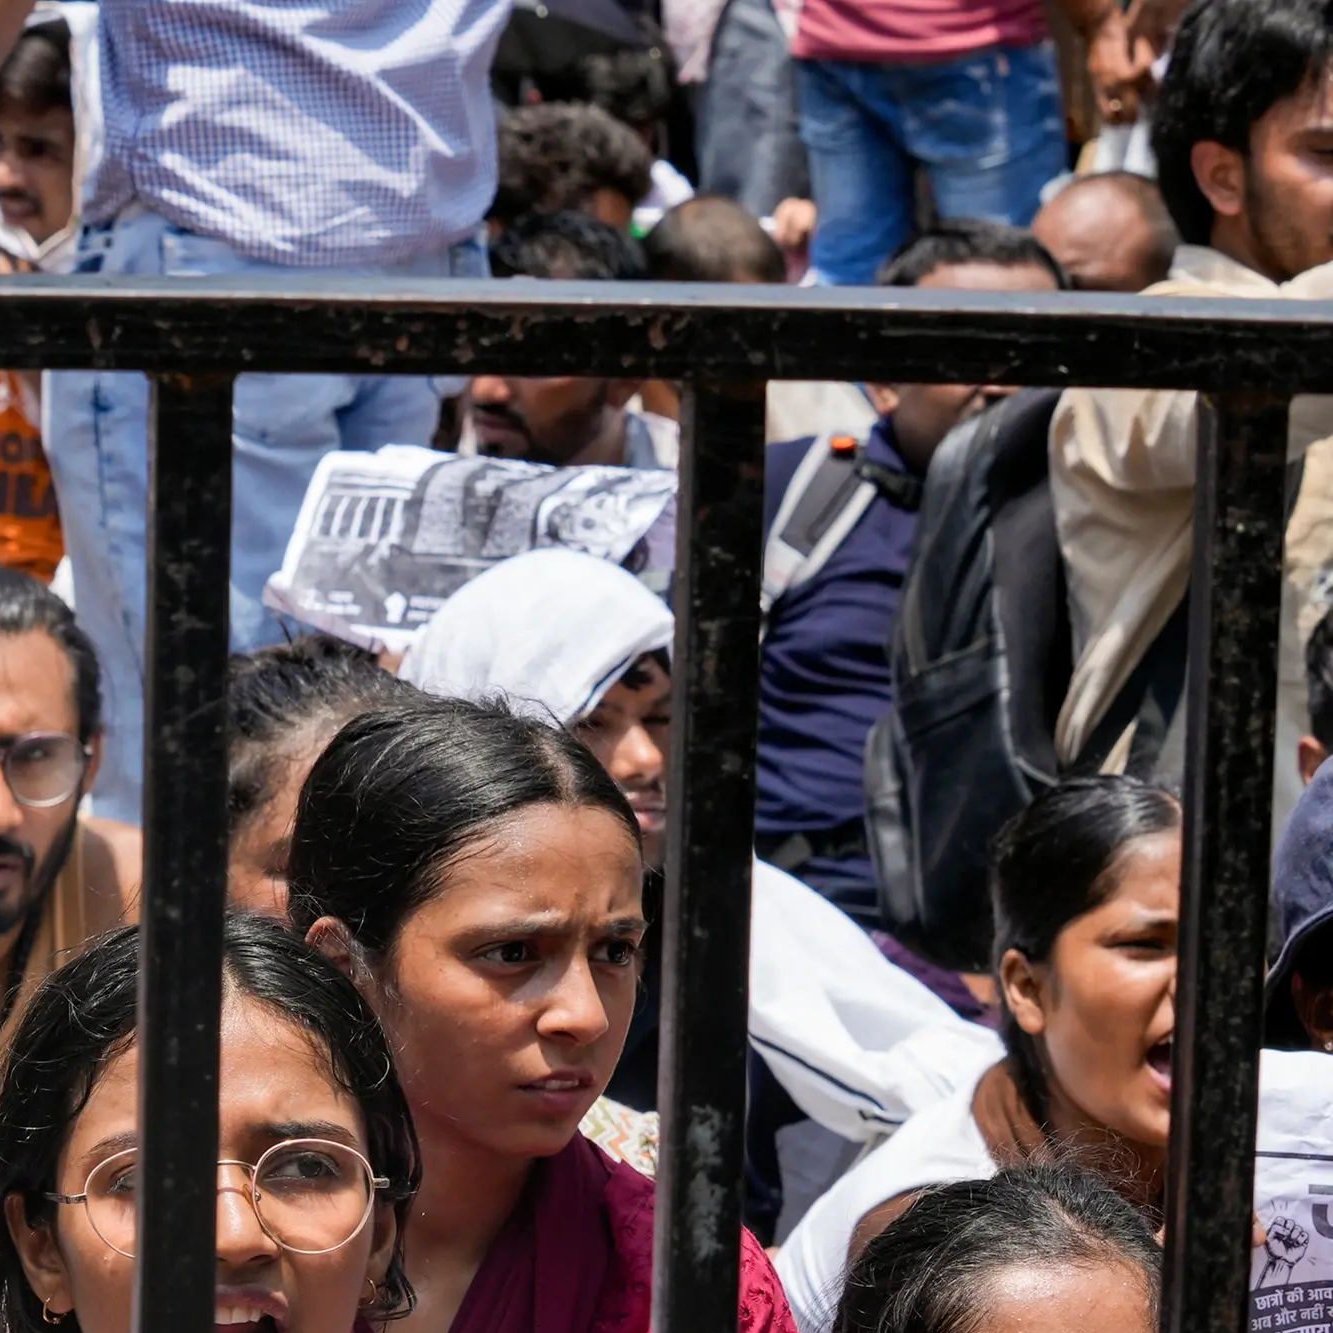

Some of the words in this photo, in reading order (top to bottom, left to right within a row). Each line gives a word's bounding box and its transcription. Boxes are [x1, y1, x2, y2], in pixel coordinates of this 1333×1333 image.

[1255, 1289, 1284, 1310] छात्रों
[1285, 1286, 1304, 1304] की
[1252, 1315, 1272, 1331] अब
[1274, 1307, 1297, 1326] और
[1299, 1303, 1325, 1320] नहीं
